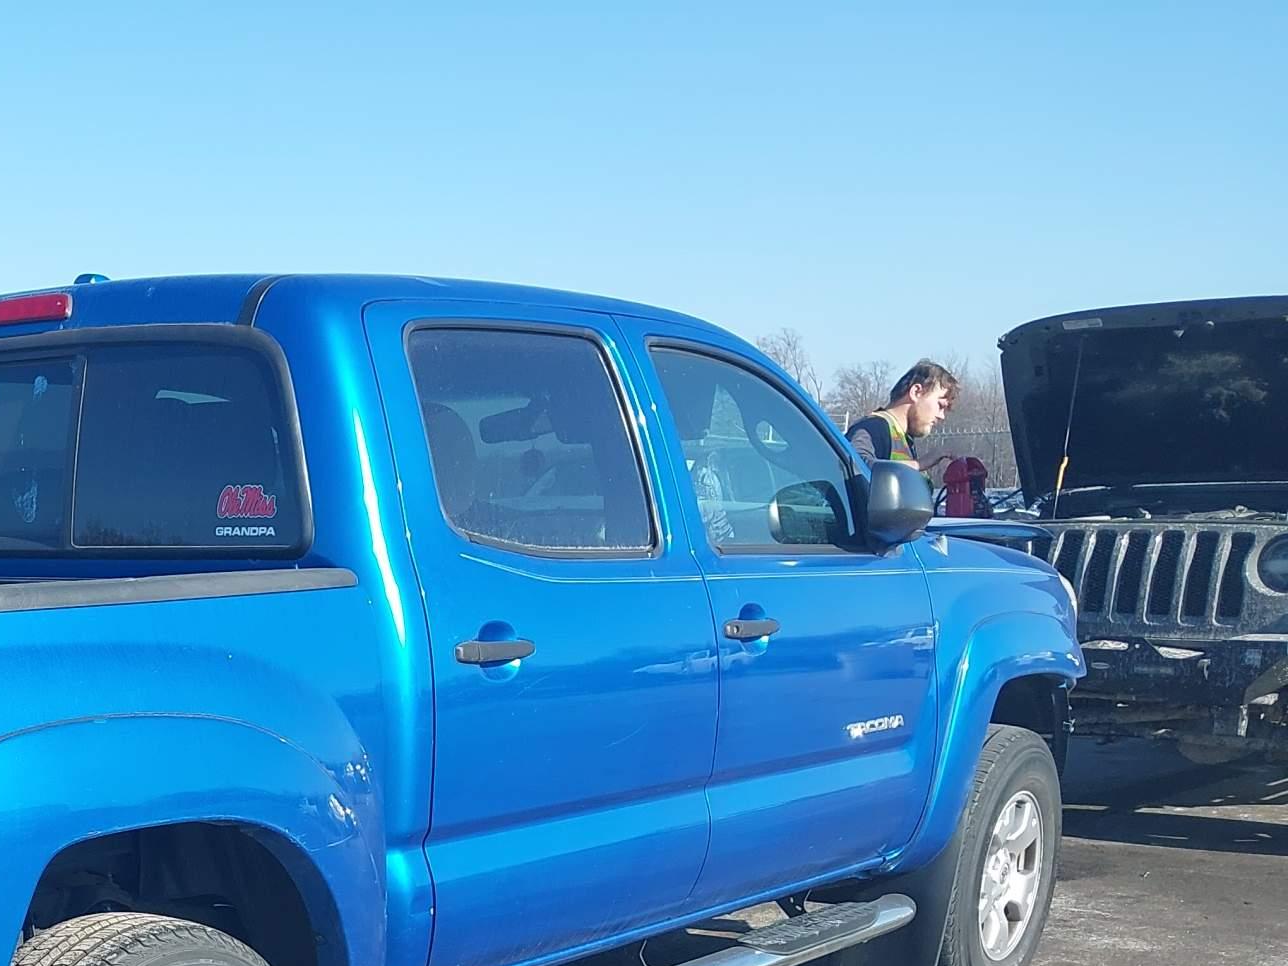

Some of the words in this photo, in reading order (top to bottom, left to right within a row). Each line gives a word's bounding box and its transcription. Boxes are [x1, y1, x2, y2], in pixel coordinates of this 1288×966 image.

[218, 485, 242, 518] Ole
[240, 485, 277, 518] Miss
[215, 526, 276, 537] GRANDPA
[846, 714, 905, 739] TACOMA
